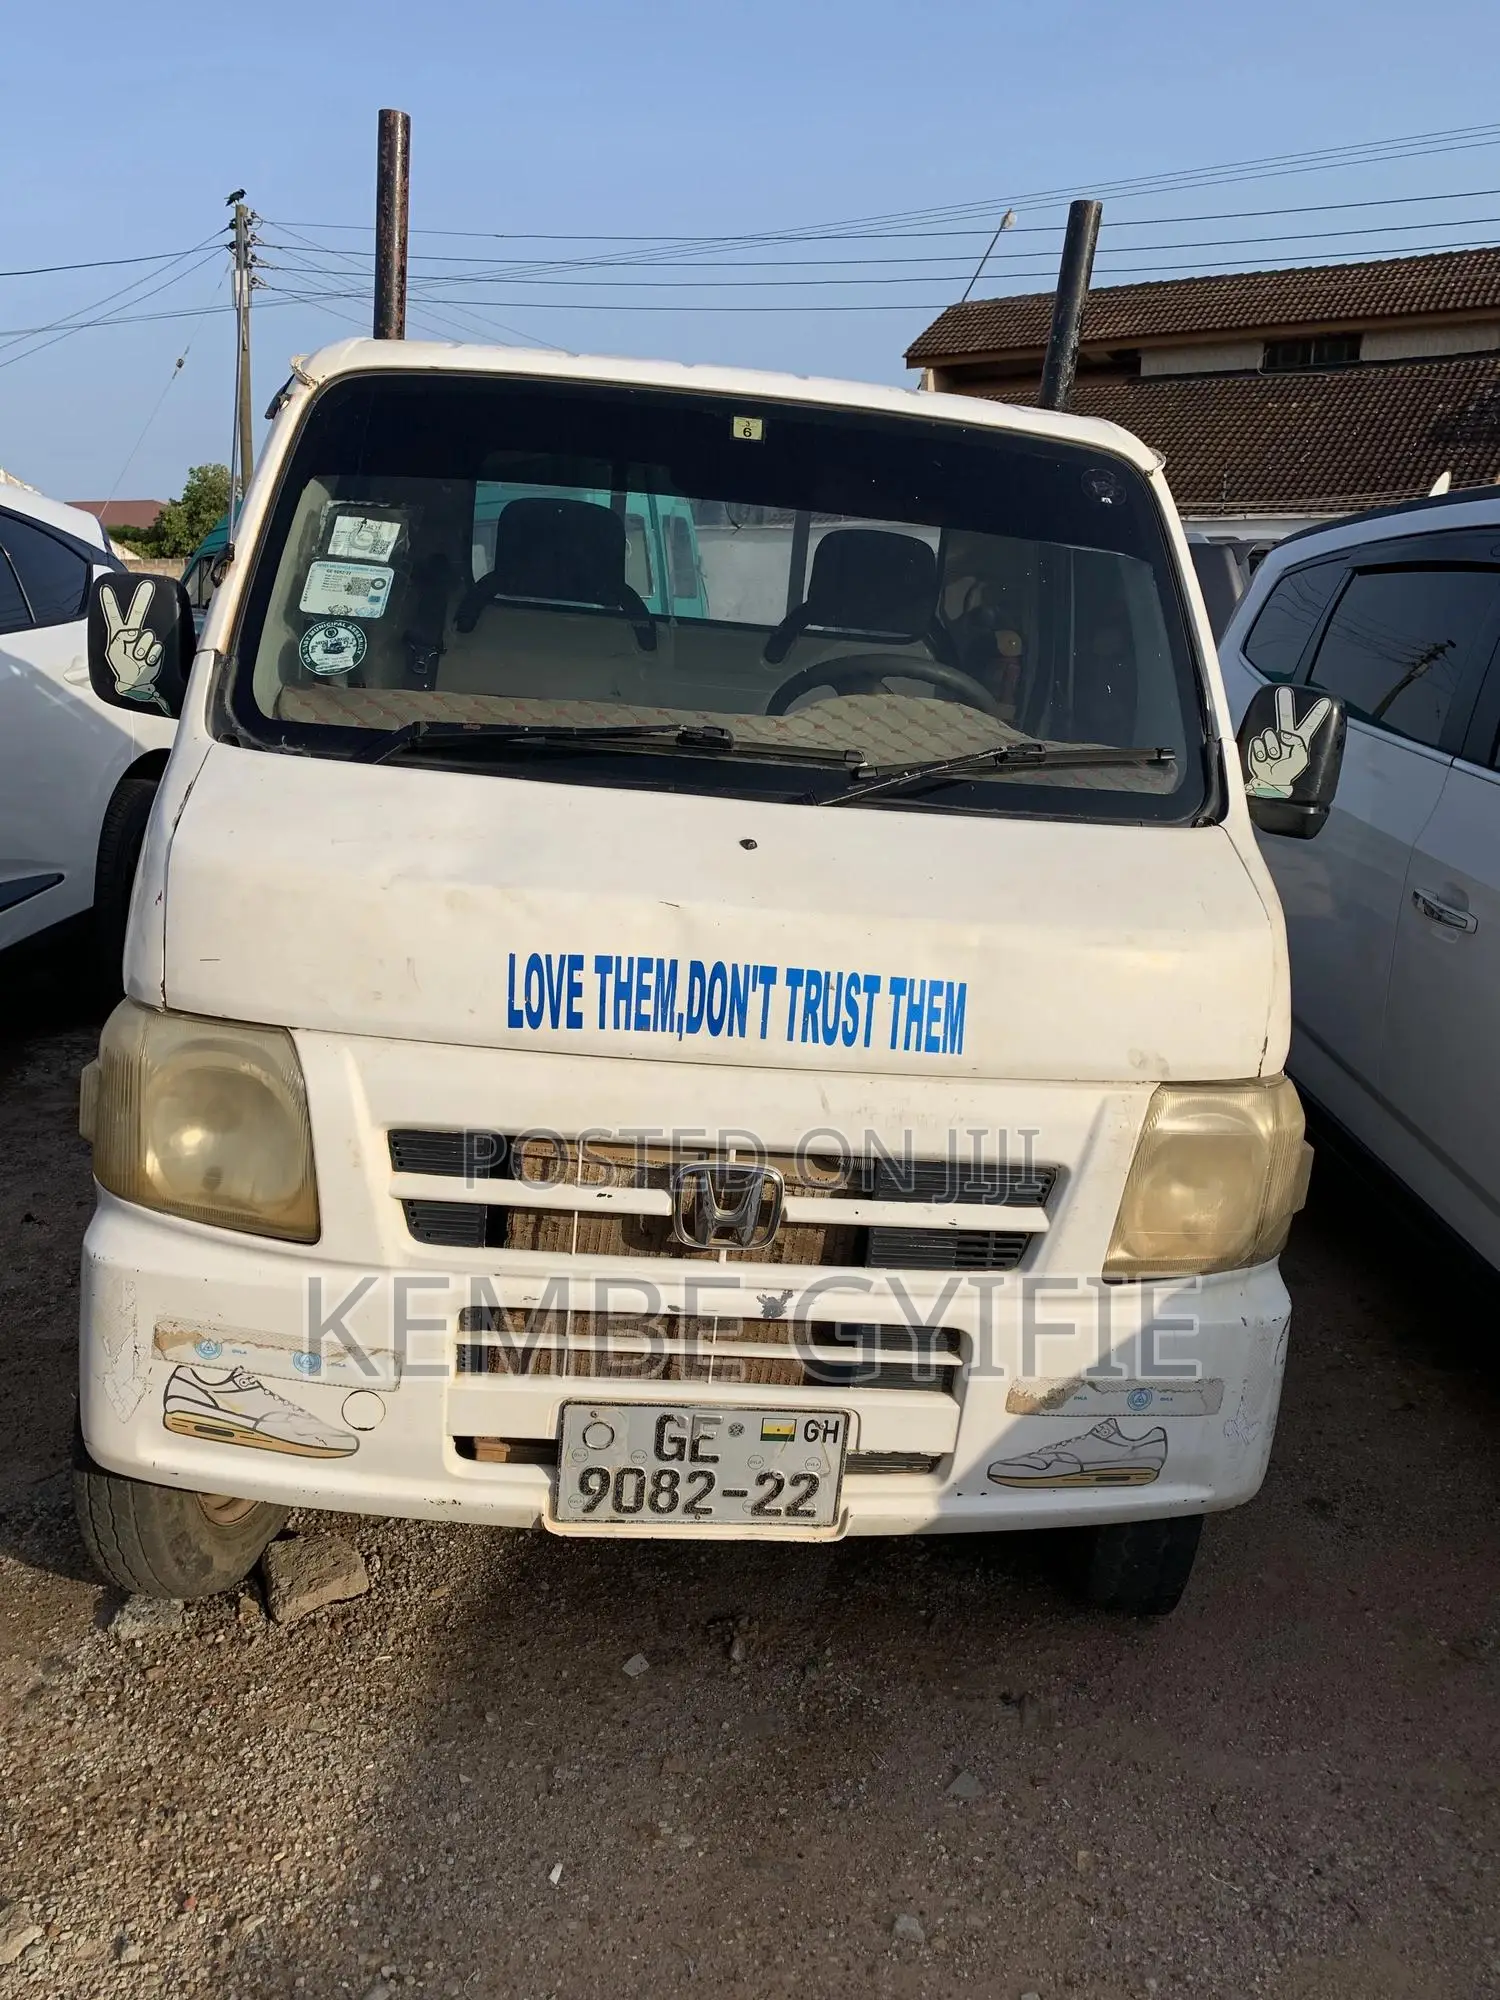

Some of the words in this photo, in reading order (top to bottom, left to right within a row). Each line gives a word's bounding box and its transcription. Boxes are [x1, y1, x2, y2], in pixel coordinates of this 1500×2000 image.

[743, 427, 752, 438] 6
[308, 621, 347, 637] MUNICIPAL
[507, 952, 584, 1030] LOVE
[785, 967, 881, 1048] TRUST
[889, 976, 967, 1055] THEM
[653, 1412, 724, 1464] GE
[803, 1419, 840, 1444] GH
[578, 1466, 820, 1518] 9082-22
